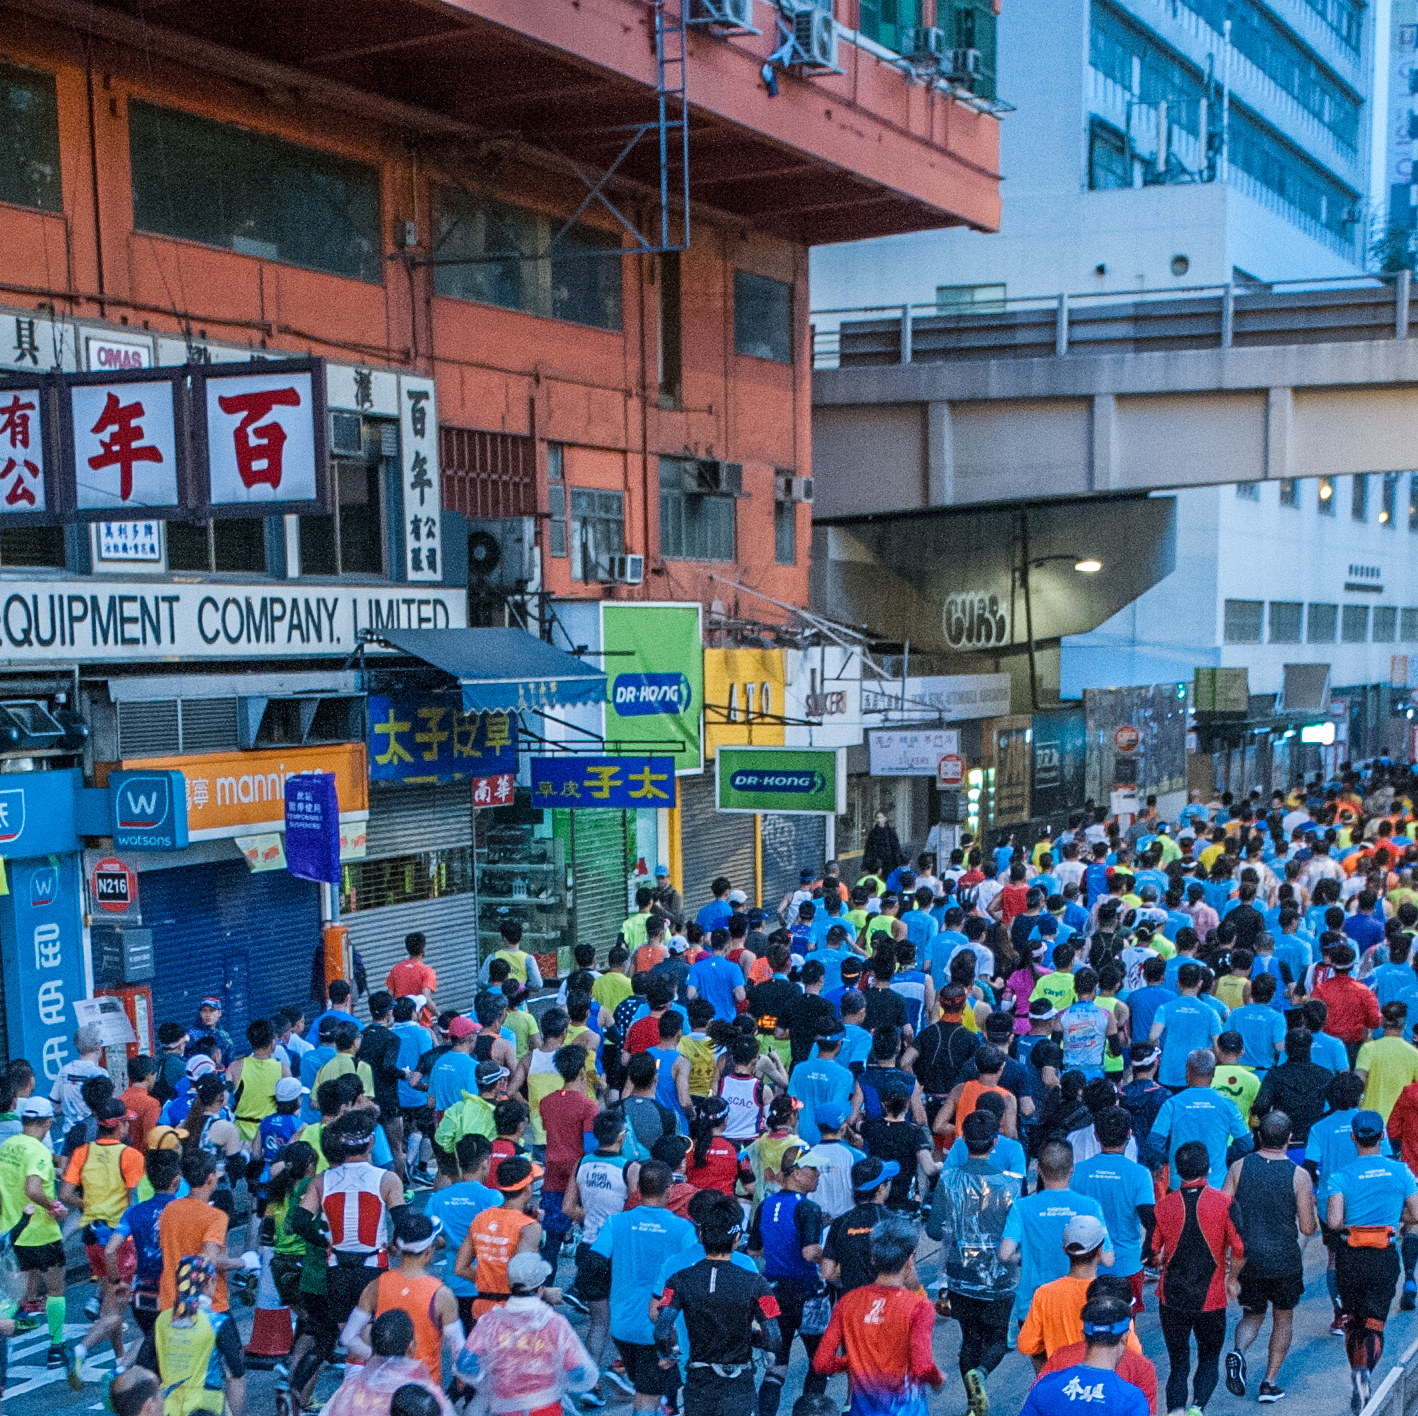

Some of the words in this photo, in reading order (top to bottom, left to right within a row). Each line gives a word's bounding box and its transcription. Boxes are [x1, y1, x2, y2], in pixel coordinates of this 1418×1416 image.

[727, 681, 773, 724] ATO
[118, 835, 172, 847] watsons
[98, 878, 127, 895] N216
